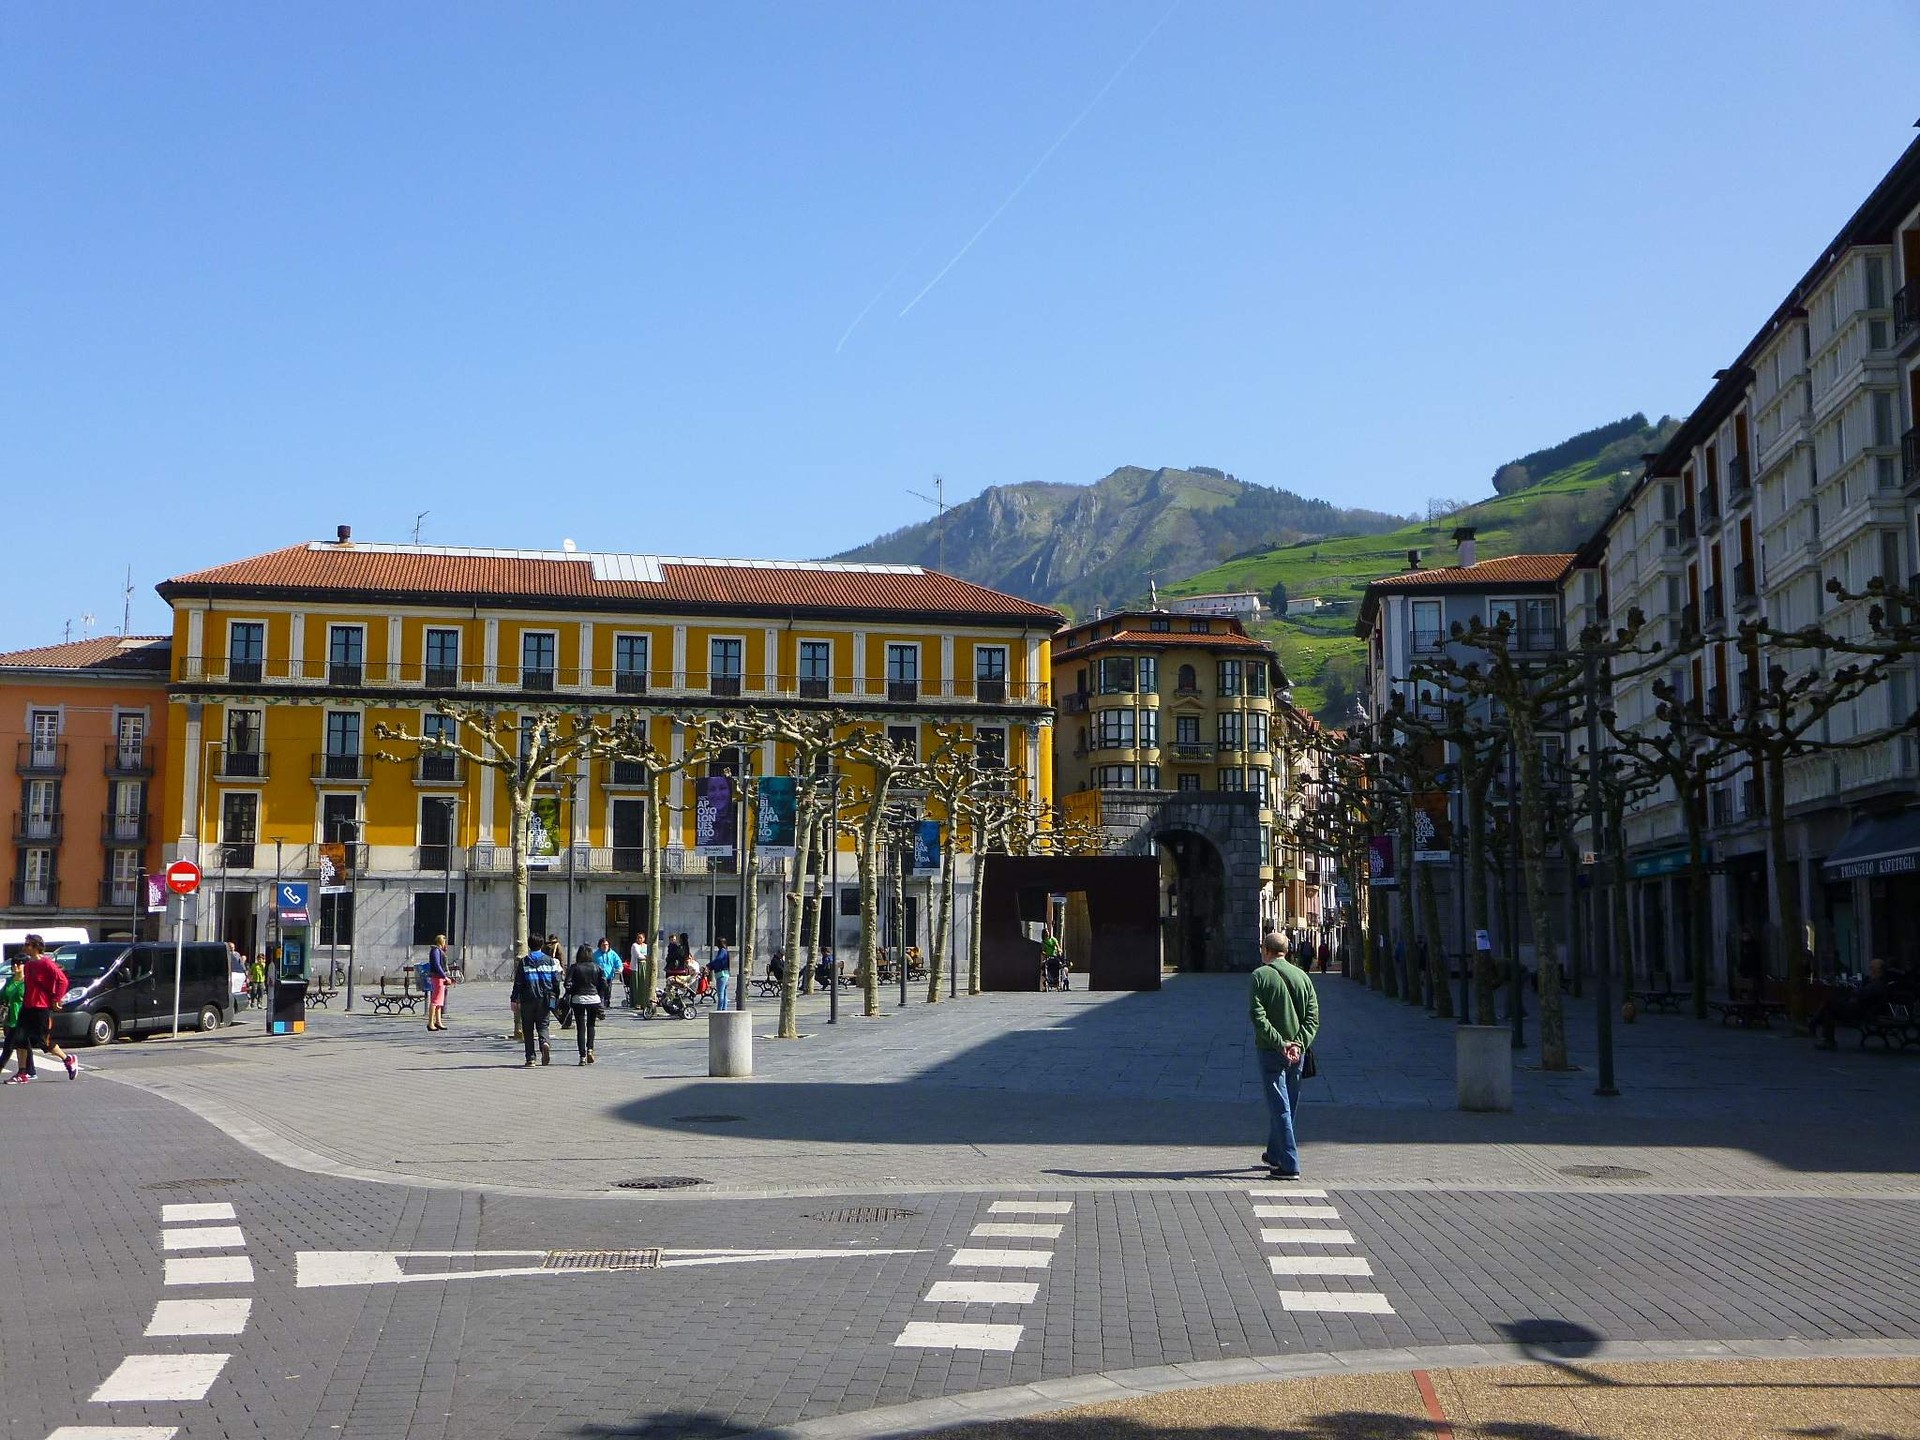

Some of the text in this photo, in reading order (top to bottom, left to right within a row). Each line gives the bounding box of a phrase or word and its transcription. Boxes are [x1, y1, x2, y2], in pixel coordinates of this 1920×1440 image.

[697, 800, 710, 808] AP
[697, 807, 717, 815] OYO
[759, 814, 780, 822] EMA
[697, 829, 715, 837] TRO
